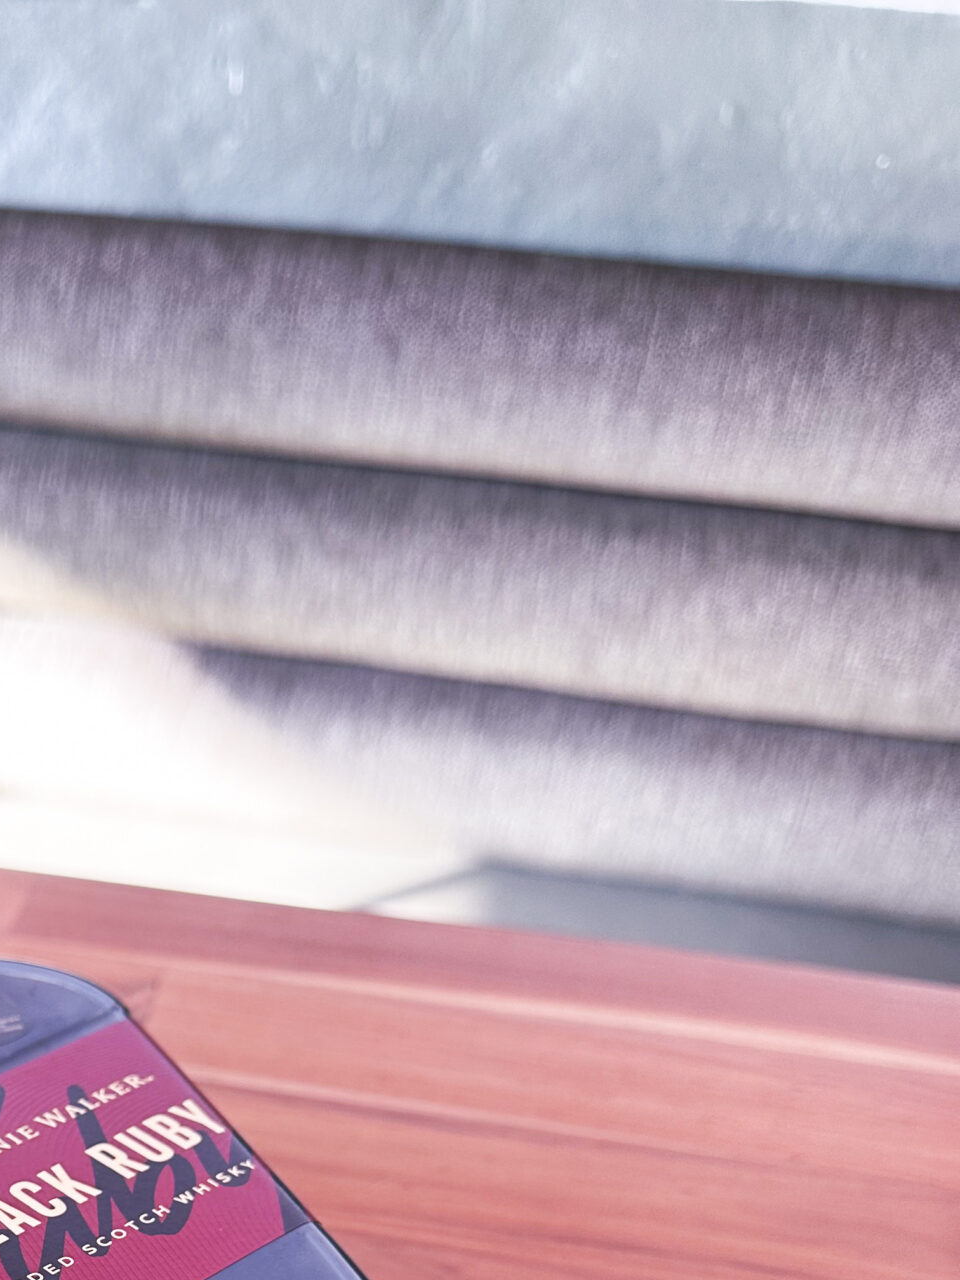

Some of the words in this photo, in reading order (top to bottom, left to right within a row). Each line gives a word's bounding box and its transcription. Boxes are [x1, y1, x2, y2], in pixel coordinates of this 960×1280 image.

[84, 1098, 225, 1179] RUBY
[81, 1204, 171, 1256] SCOTCH
[173, 1159, 256, 1205] WHISKY
